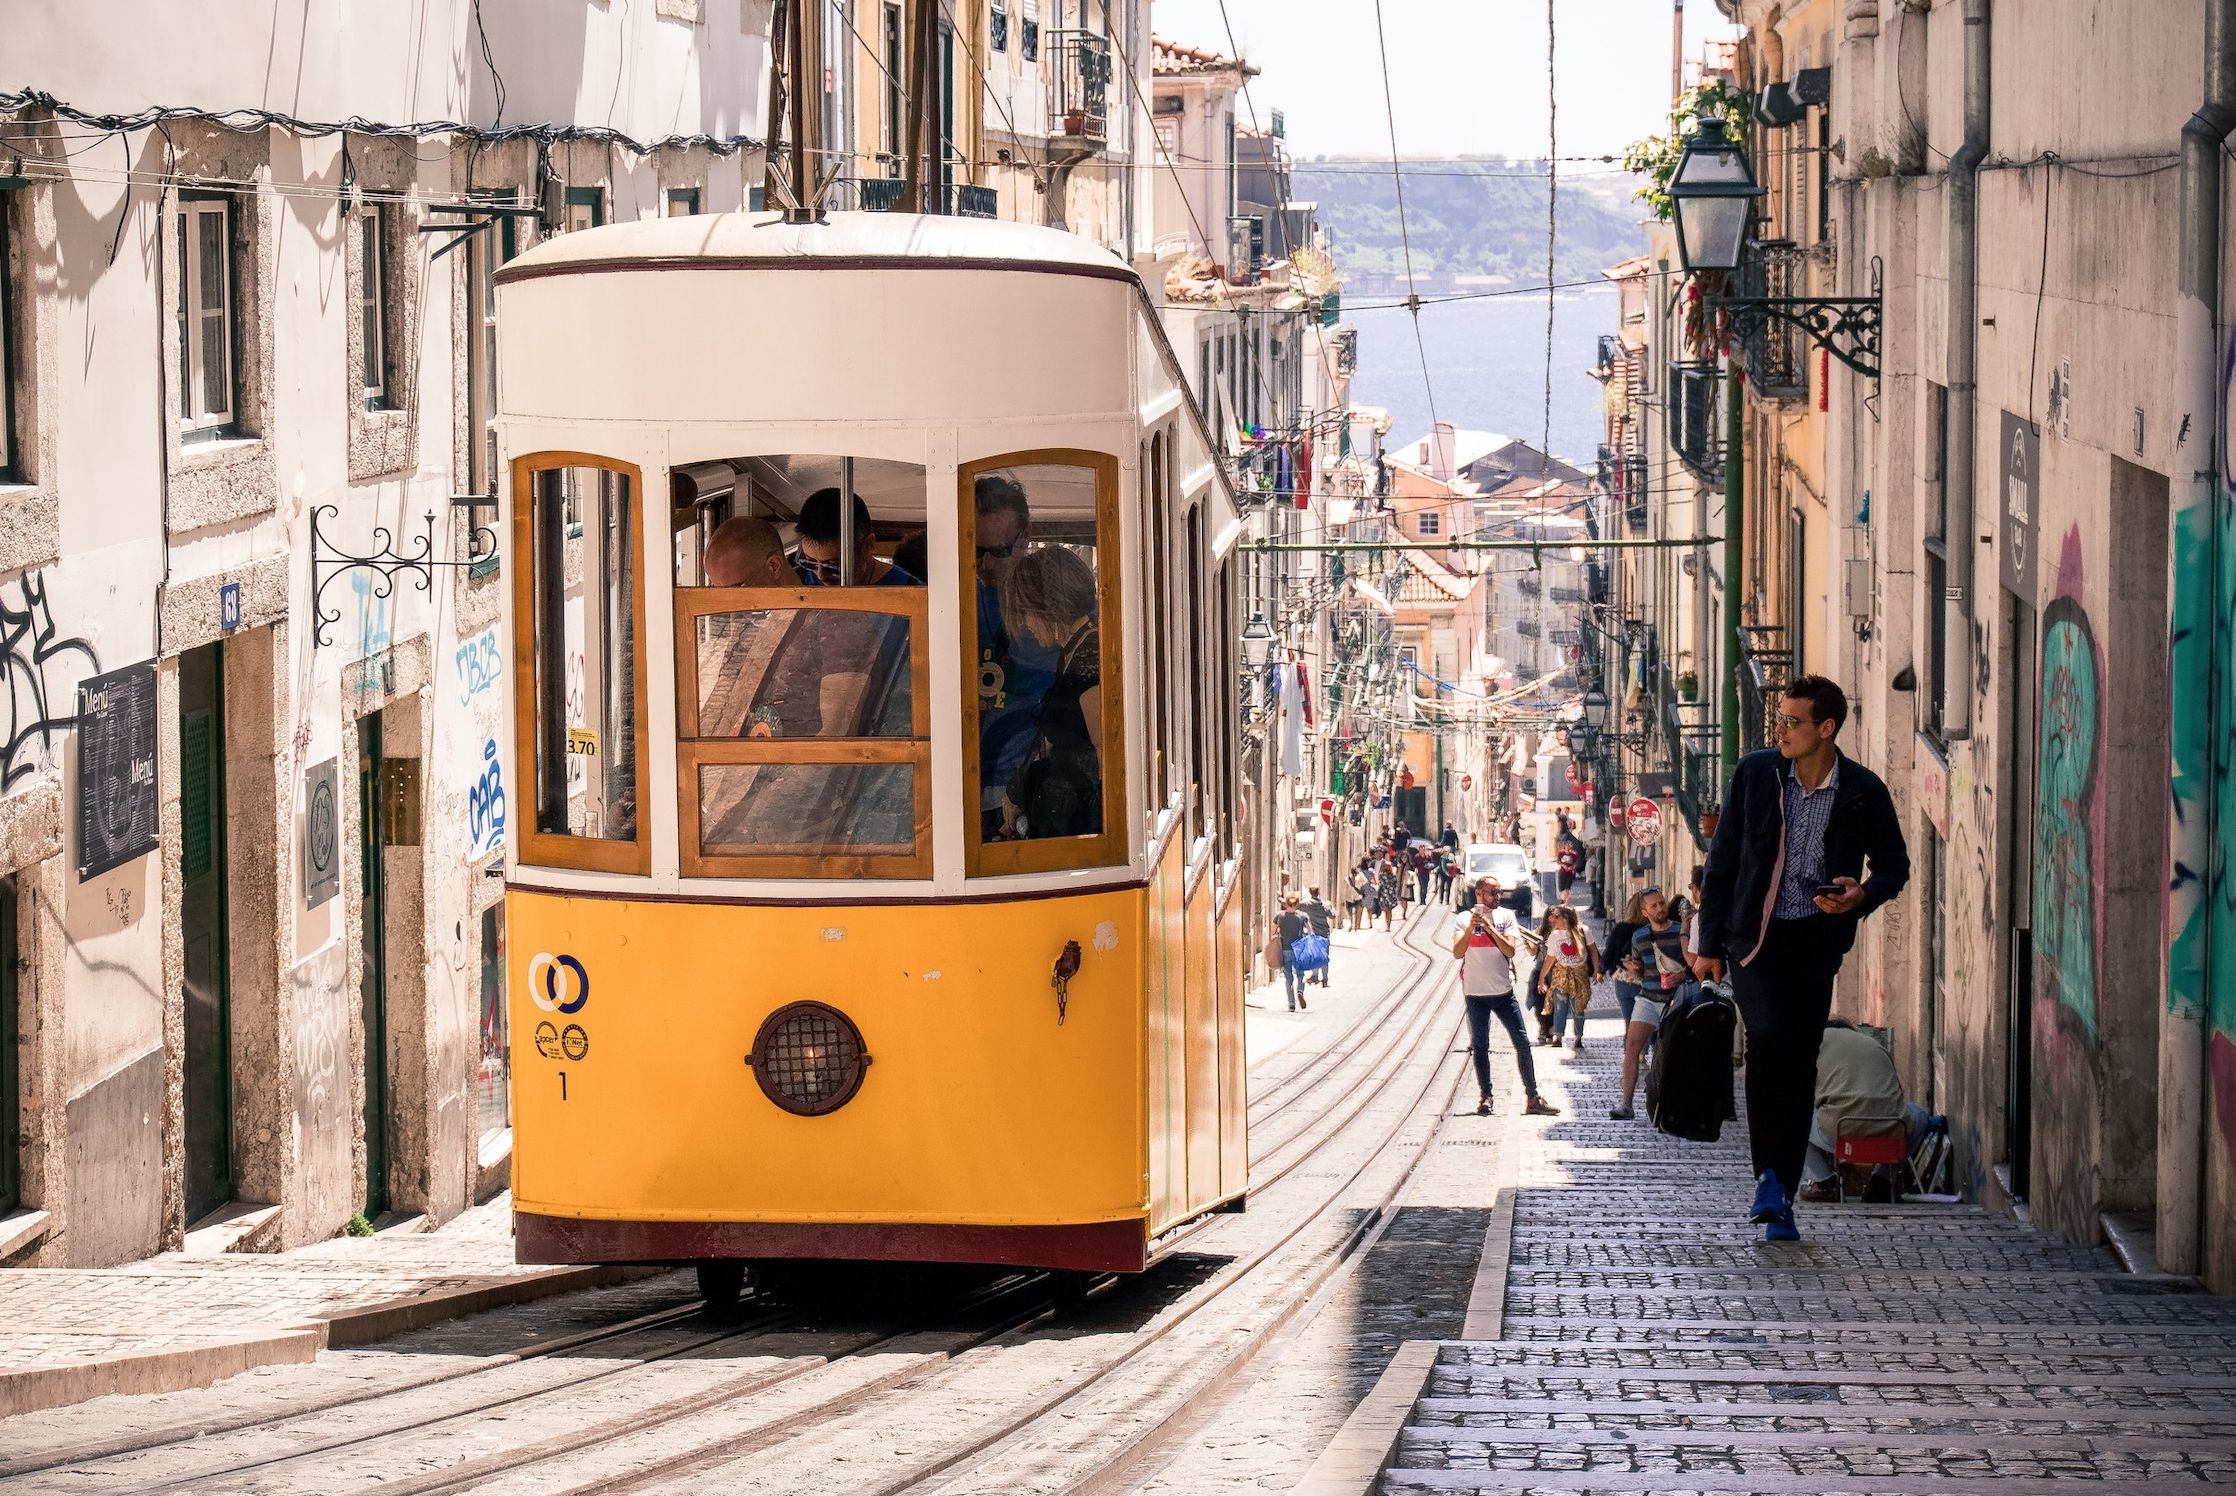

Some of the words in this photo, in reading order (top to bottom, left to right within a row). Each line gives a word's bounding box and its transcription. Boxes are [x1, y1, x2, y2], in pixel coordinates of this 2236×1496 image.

[225, 589, 237, 623] 68
[84, 683, 109, 715] Menú
[568, 739, 595, 756] 3.70
[131, 752, 153, 784] Menú
[558, 1072, 567, 1101] 1
